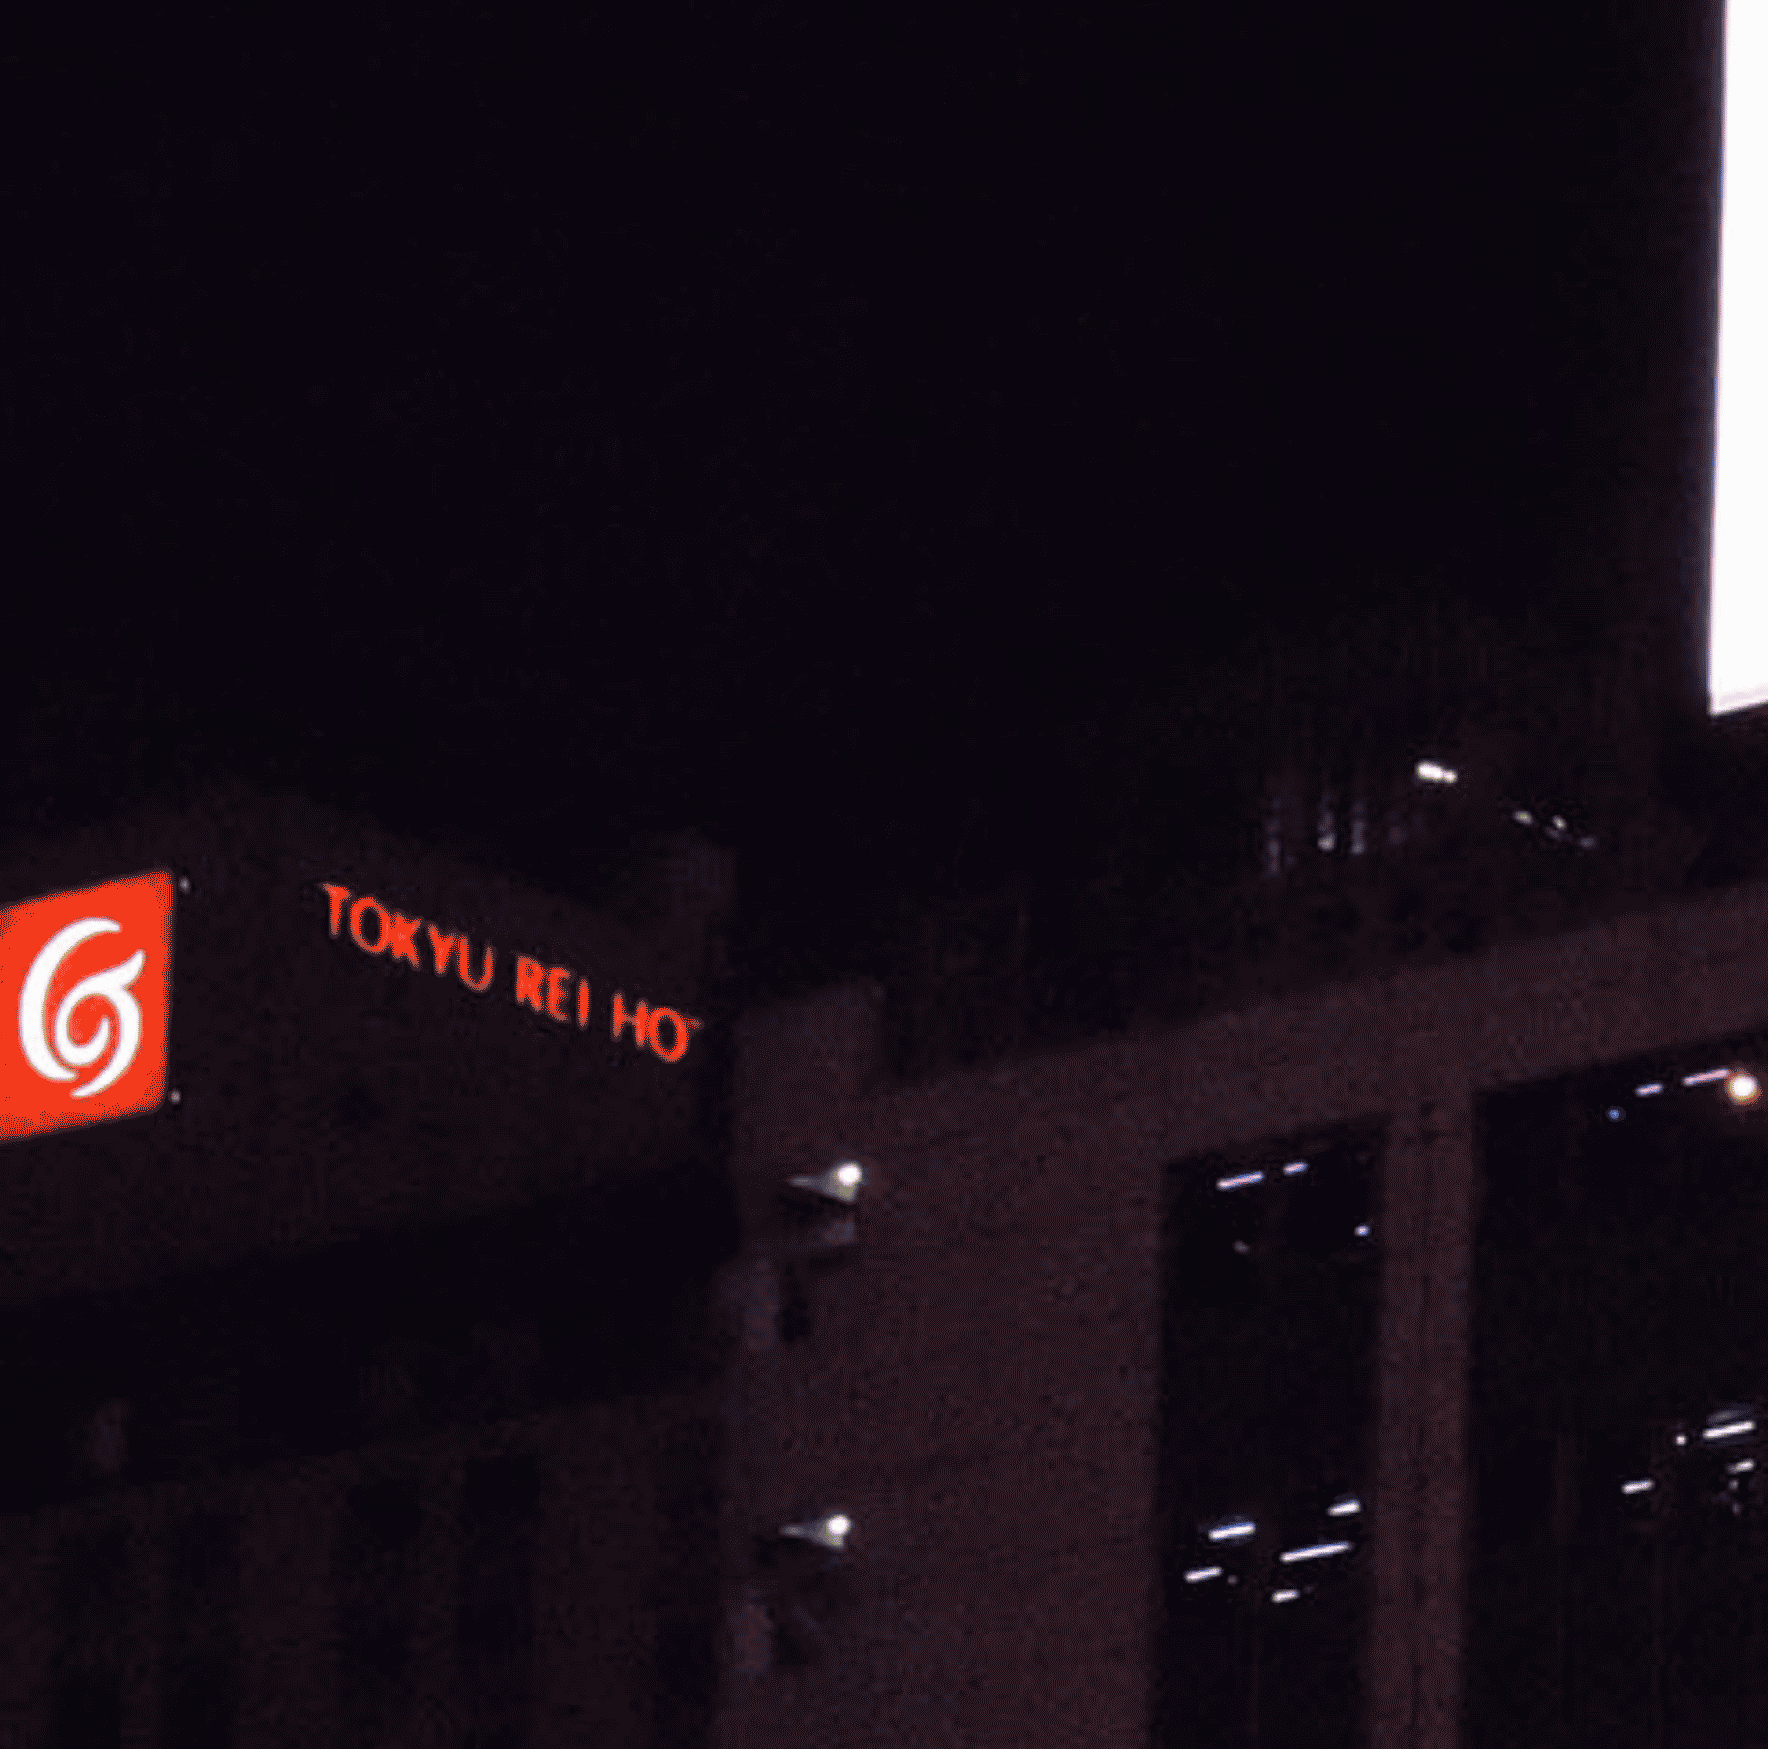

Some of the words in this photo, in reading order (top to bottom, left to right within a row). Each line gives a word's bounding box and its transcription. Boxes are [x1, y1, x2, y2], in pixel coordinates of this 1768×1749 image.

[322, 881, 496, 993] TOKYU
[514, 955, 591, 1028] REI
[611, 991, 703, 1063] HO
